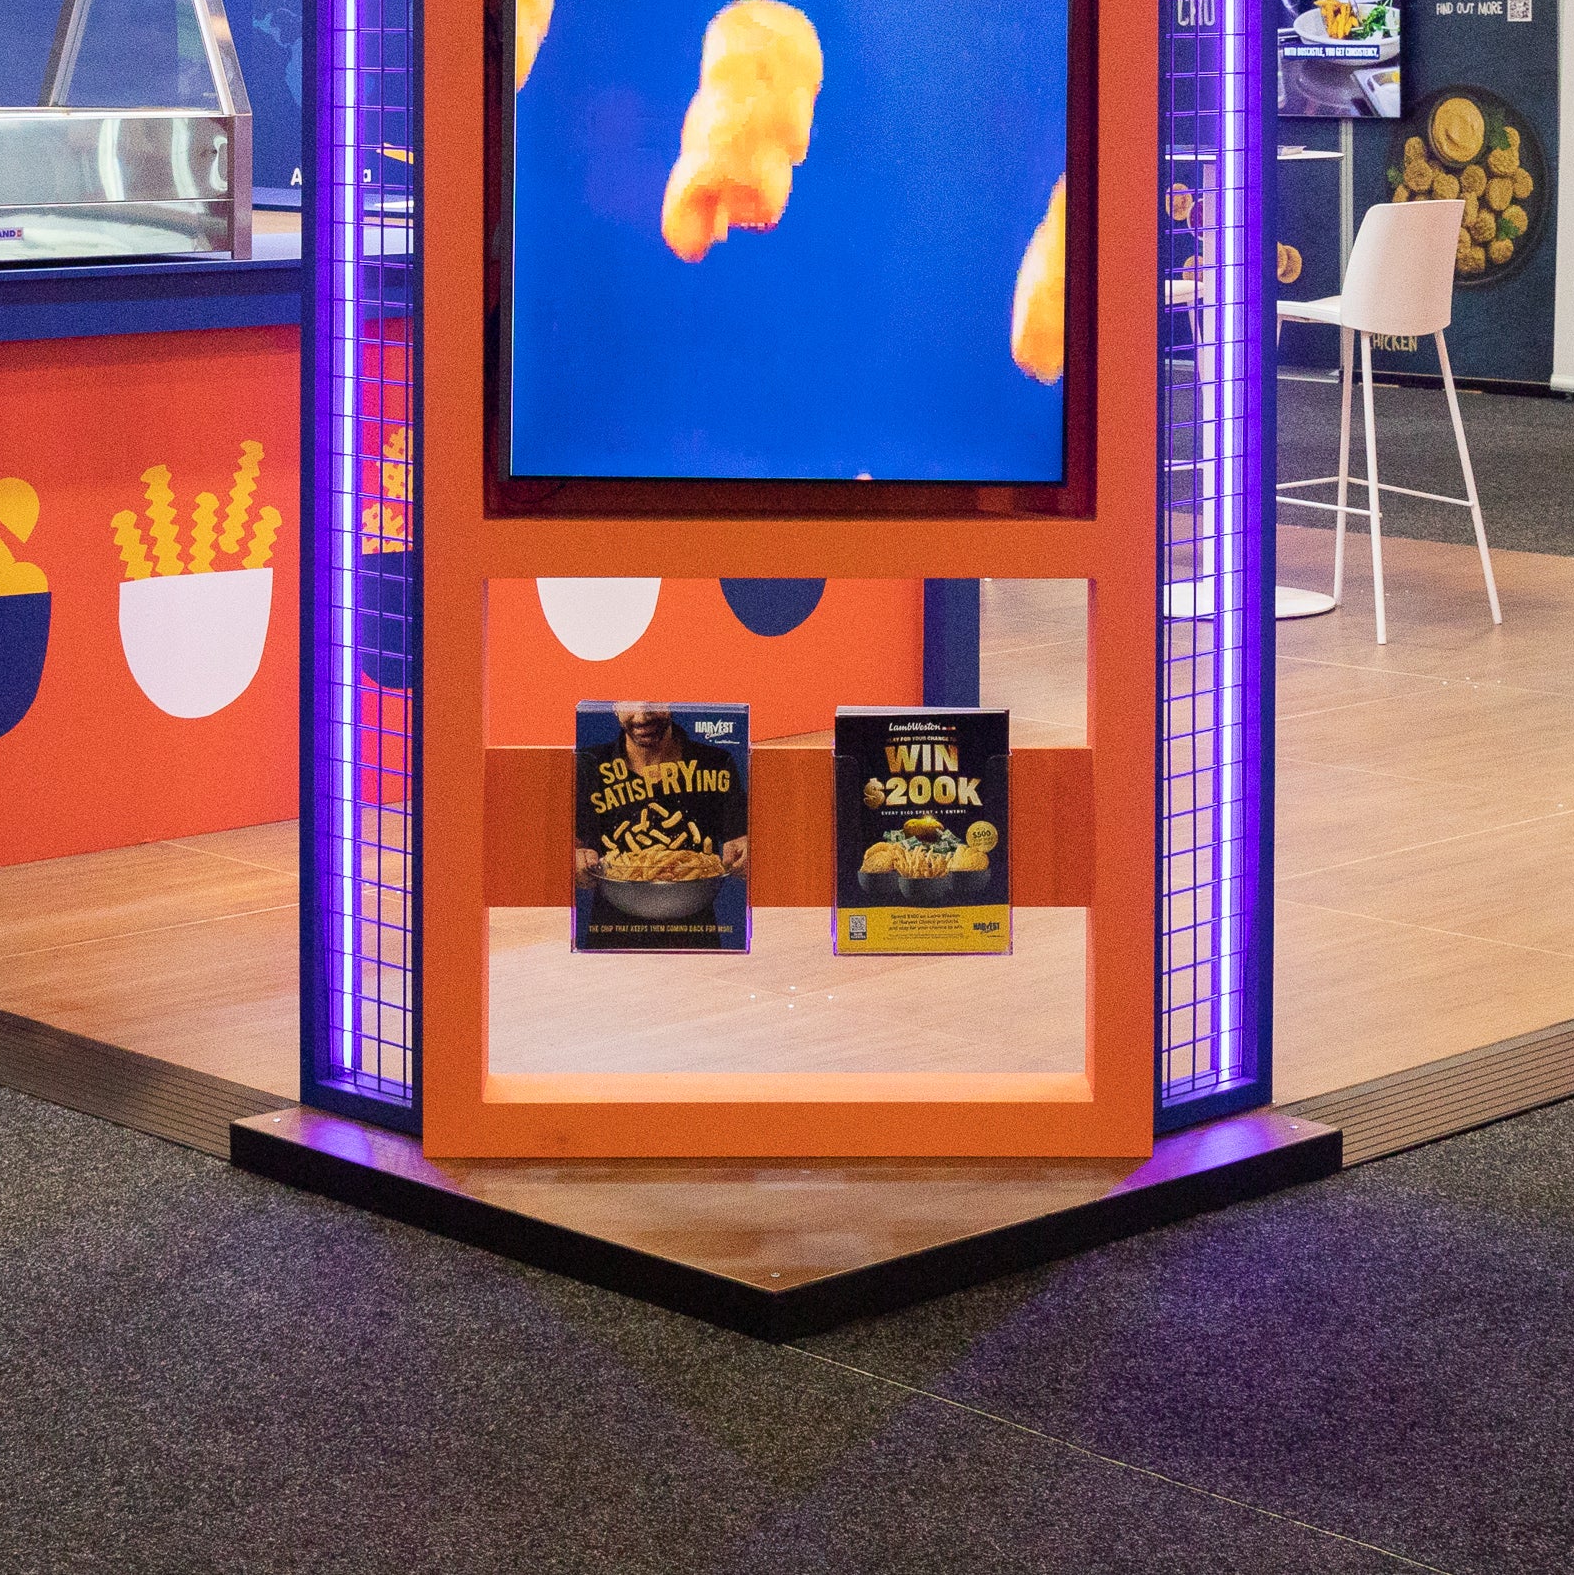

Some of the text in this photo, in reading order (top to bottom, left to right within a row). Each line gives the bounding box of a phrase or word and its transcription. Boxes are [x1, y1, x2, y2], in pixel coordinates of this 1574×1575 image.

[1436, 1, 1503, 16] FIND OUT MORE
[1371, 333, 1418, 352] HICKEN
[695, 719, 735, 734] HARVEST
[889, 722, 941, 732] LambWeston
[885, 744, 958, 773] WIN
[599, 758, 628, 785] SO
[863, 775, 983, 809] $200K
